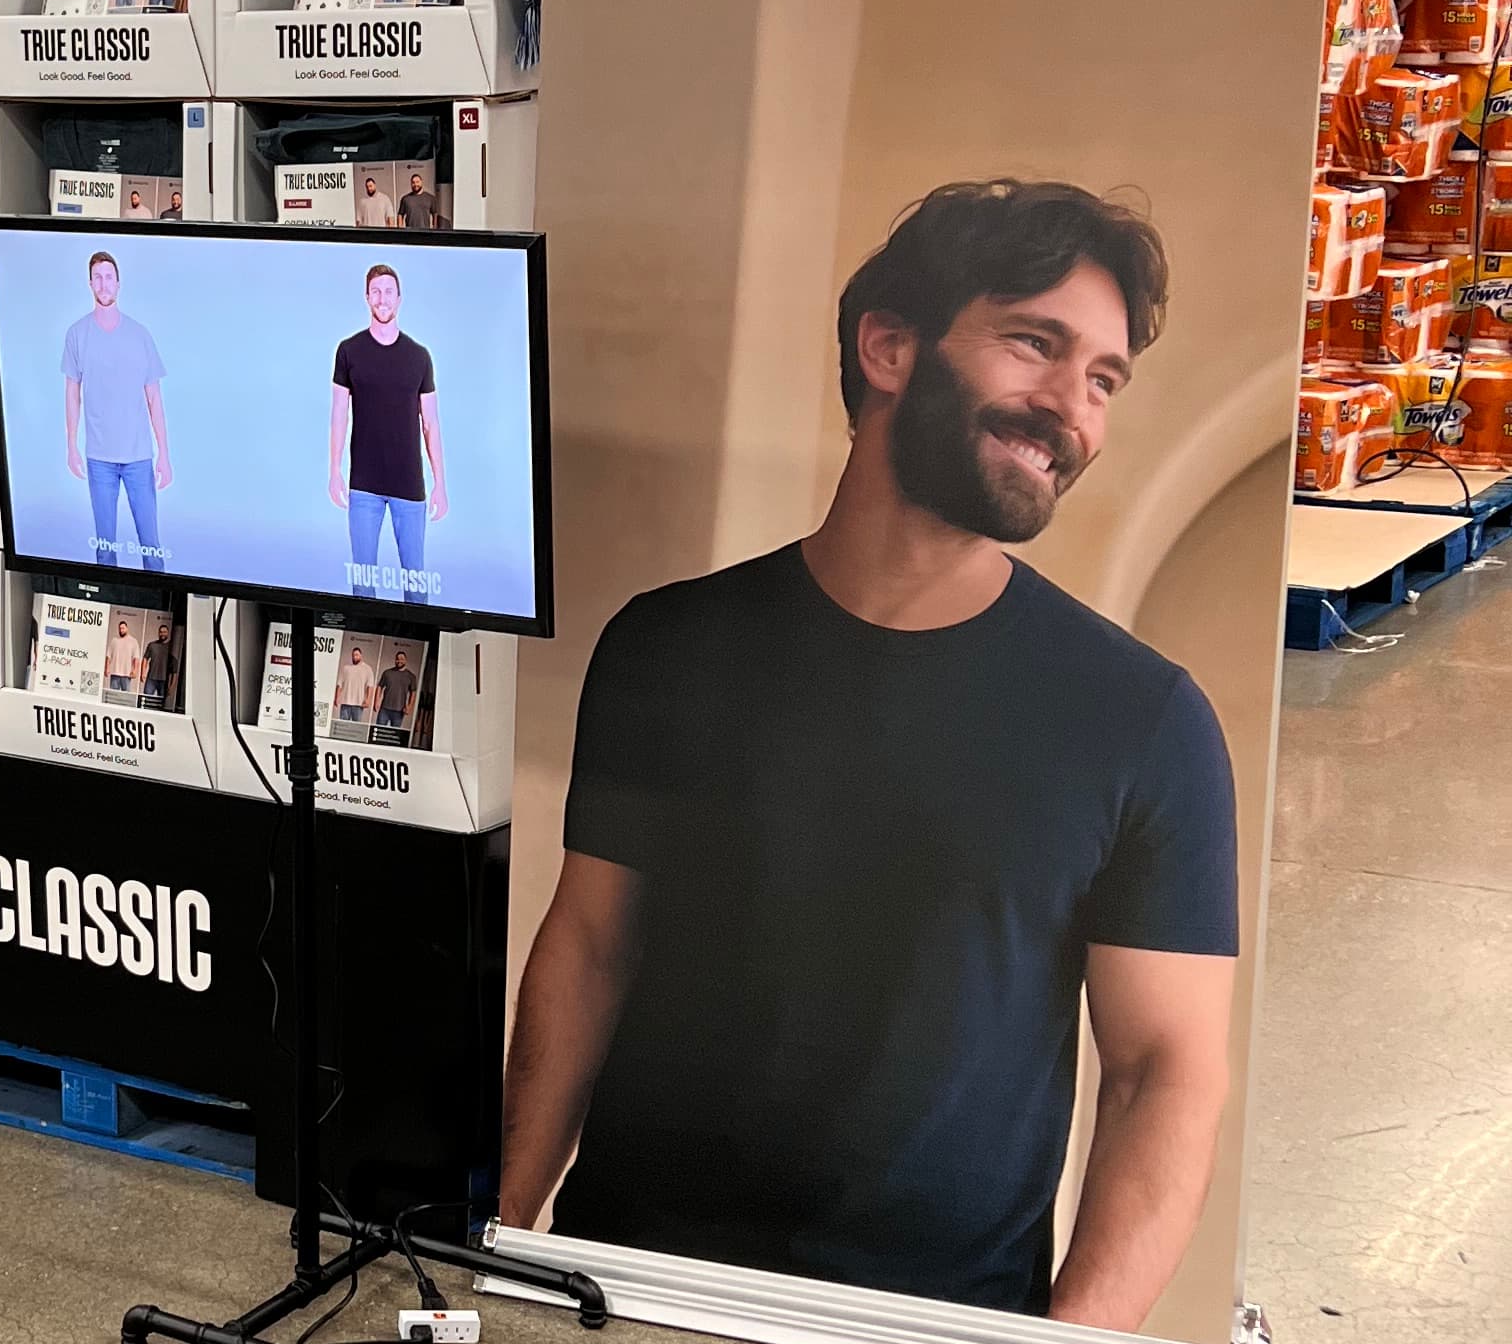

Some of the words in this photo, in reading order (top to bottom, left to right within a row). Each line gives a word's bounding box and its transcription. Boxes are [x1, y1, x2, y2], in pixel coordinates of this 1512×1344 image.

[1441, 11, 1456, 23] 15
[20, 29, 67, 61] TRUE
[71, 28, 150, 62] CLASSIC
[275, 24, 328, 59] TRUE
[332, 21, 422, 57] CLASSIC
[39, 72, 58, 81] Look
[60, 72, 86, 81] Good.
[88, 72, 106, 81] Feel
[107, 72, 133, 81] Good.
[295, 70, 317, 79] Look
[319, 69, 347, 79] Good.
[349, 69, 370, 78] Feel
[371, 69, 400, 78] Good.
[461, 113, 477, 124] XL
[284, 173, 306, 190] TRUE
[306, 172, 347, 189] CLASSIC
[1429, 203, 1444, 215] 15
[1350, 319, 1365, 330] 15
[88, 536, 124, 553] Other
[344, 562, 380, 589] TRUE
[382, 566, 441, 595] CLASSIC
[47, 603, 66, 621] TRUE
[67, 606, 103, 626] CLASSIC
[43, 644, 66, 655] CREW
[66, 647, 89, 659] NECK
[42, 654, 73, 667] 2-PACK
[33, 705, 78, 740] TRUE
[80, 712, 156, 752] CLASSIC
[50, 744, 70, 755] Look
[71, 746, 95, 760] Good.
[96, 751, 114, 762] Feel
[115, 754, 140, 767] Good.
[325, 751, 410, 793] CLASSIC
